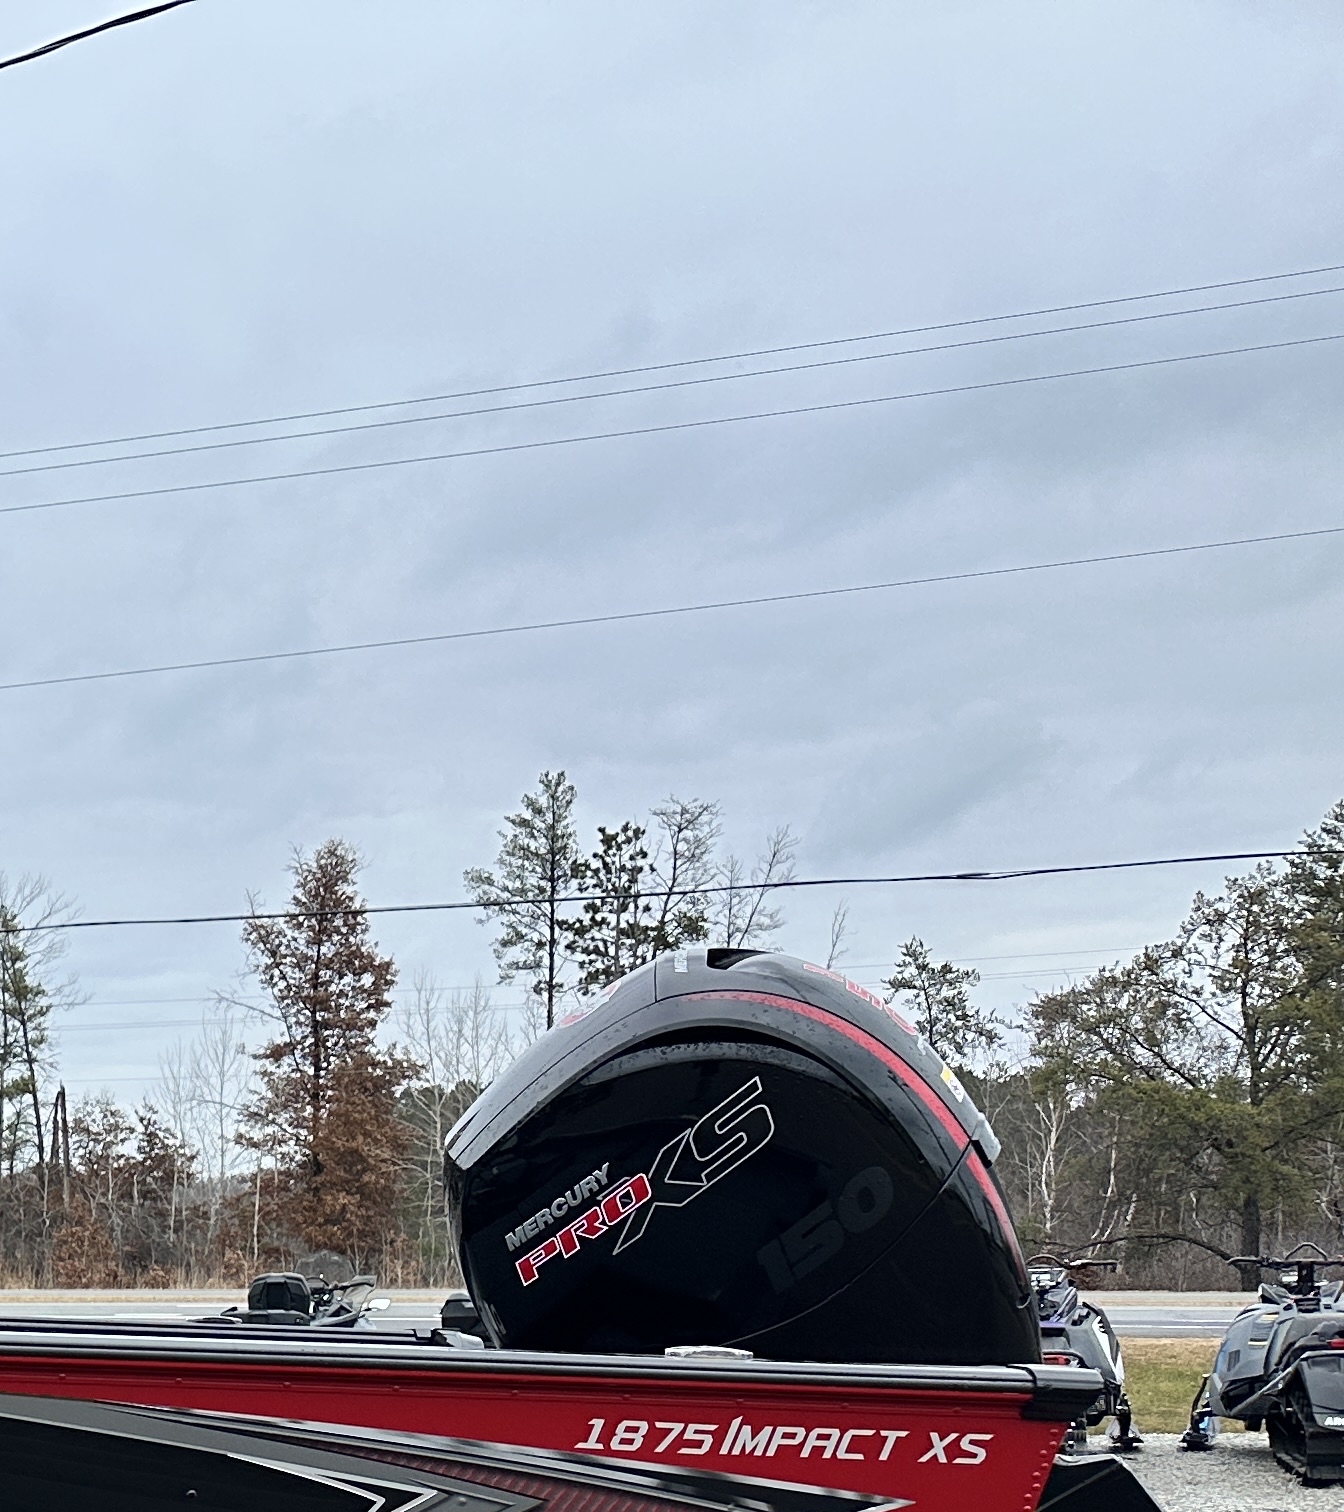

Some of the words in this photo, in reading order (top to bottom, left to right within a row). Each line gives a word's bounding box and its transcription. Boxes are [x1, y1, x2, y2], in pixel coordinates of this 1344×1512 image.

[504, 1162, 610, 1252] MERCURY
[756, 1166, 894, 1294] 150
[574, 1418, 719, 1455] 1875
[718, 1415, 910, 1461] IMPACT
[917, 1431, 994, 1465] XS
